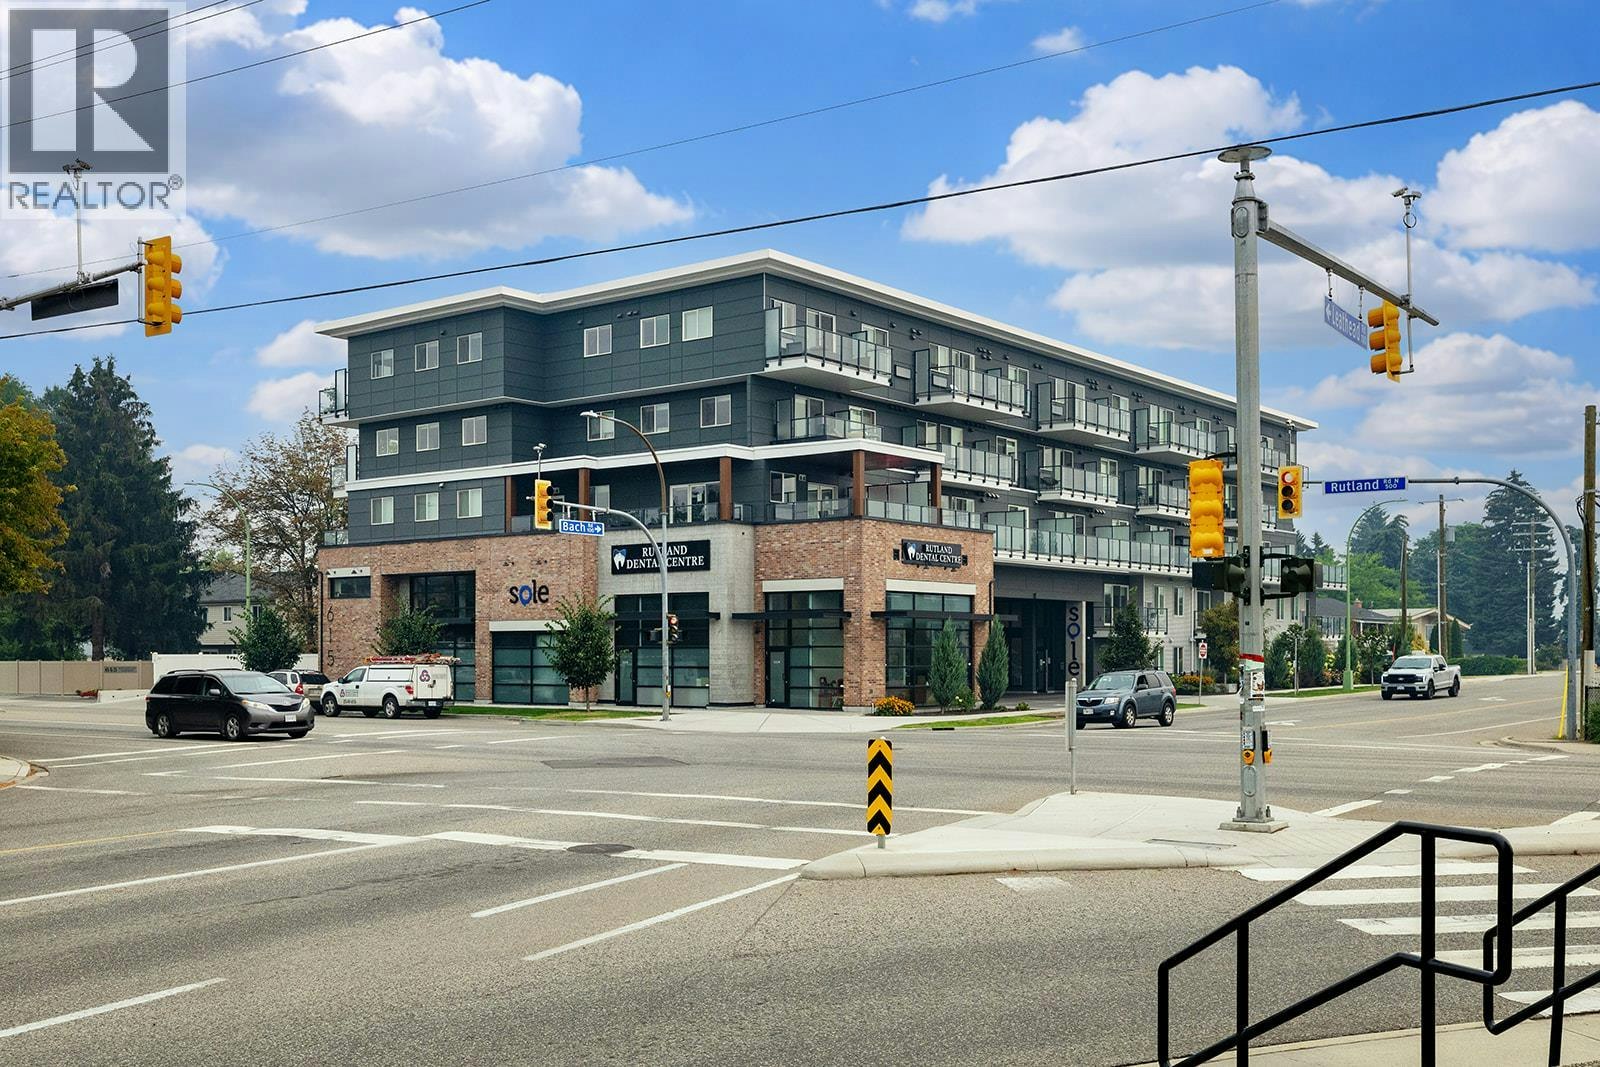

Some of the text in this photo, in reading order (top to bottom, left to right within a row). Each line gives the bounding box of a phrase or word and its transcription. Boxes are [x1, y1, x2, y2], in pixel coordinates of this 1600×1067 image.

[1331, 479, 1379, 492] Rutland
[562, 521, 586, 532] Bach
[642, 545, 688, 557] RUAND
[925, 543, 953, 554] RUTLAND
[626, 555, 705, 569] DENTA CENTRE
[915, 552, 962, 564] DENTAL CENTRE
[509, 579, 549, 607] sole
[1067, 606, 1081, 676] sole
